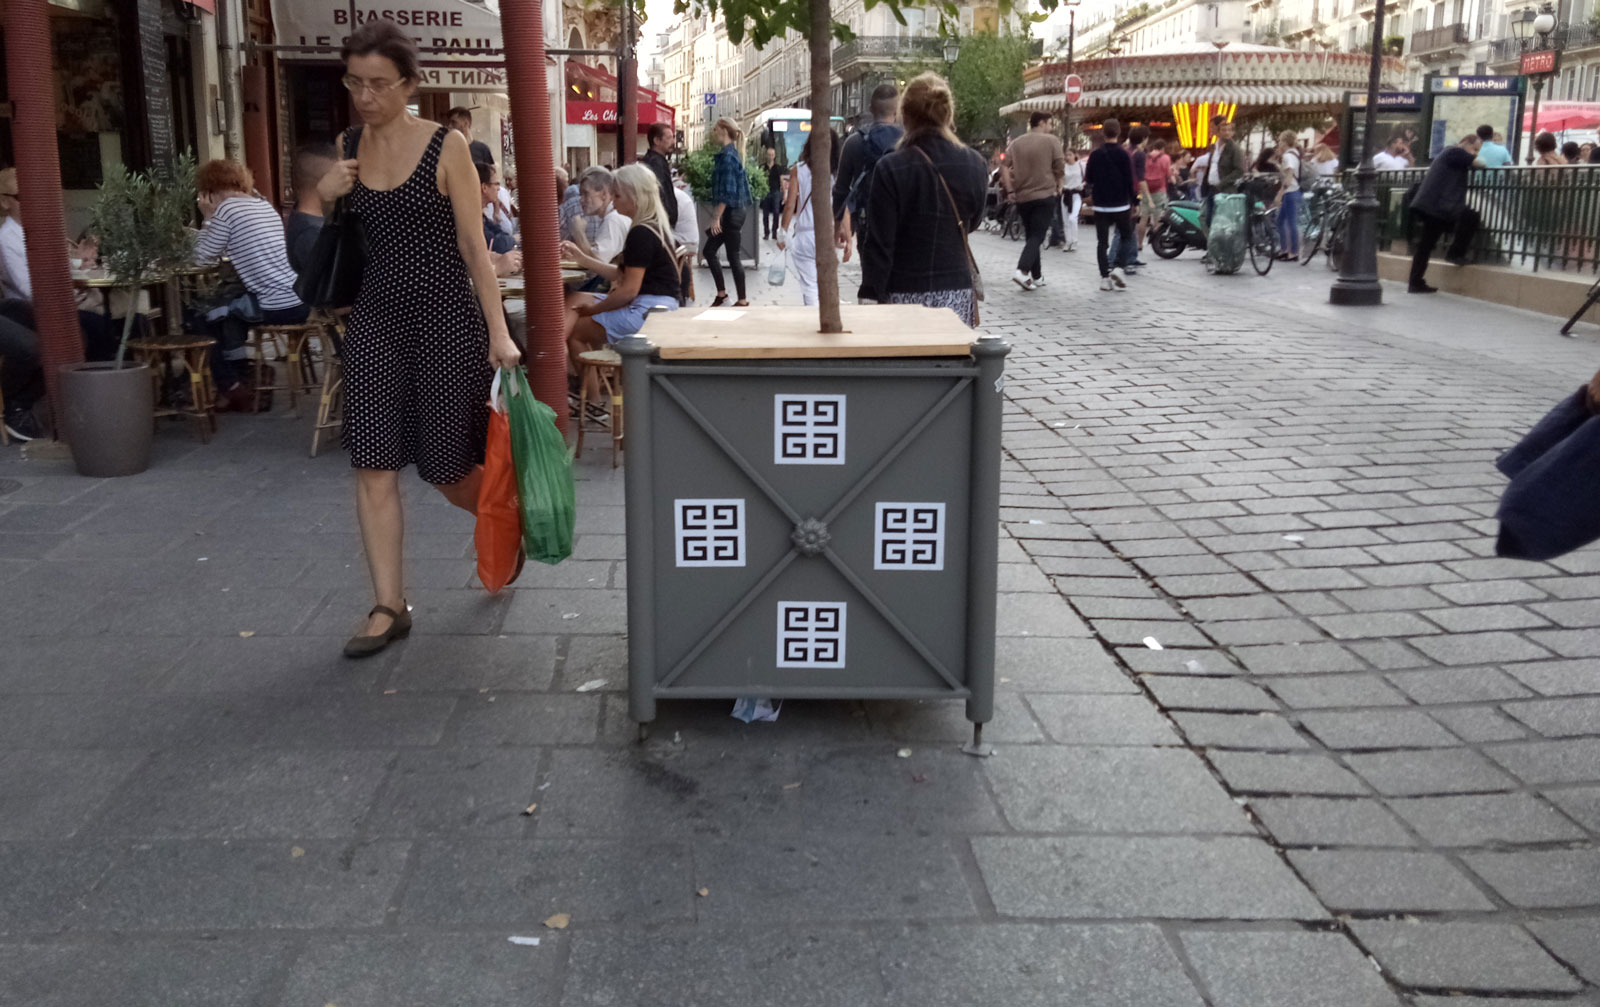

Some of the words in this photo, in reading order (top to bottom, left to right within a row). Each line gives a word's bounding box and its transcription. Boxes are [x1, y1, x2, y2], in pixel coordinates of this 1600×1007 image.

[333, 9, 463, 27] BRASSERIE
[300, 36, 331, 54] LE
[432, 37, 499, 56] PAUL
[1461, 79, 1508, 89] Saint-Paul
[582, 109, 599, 121] Les
